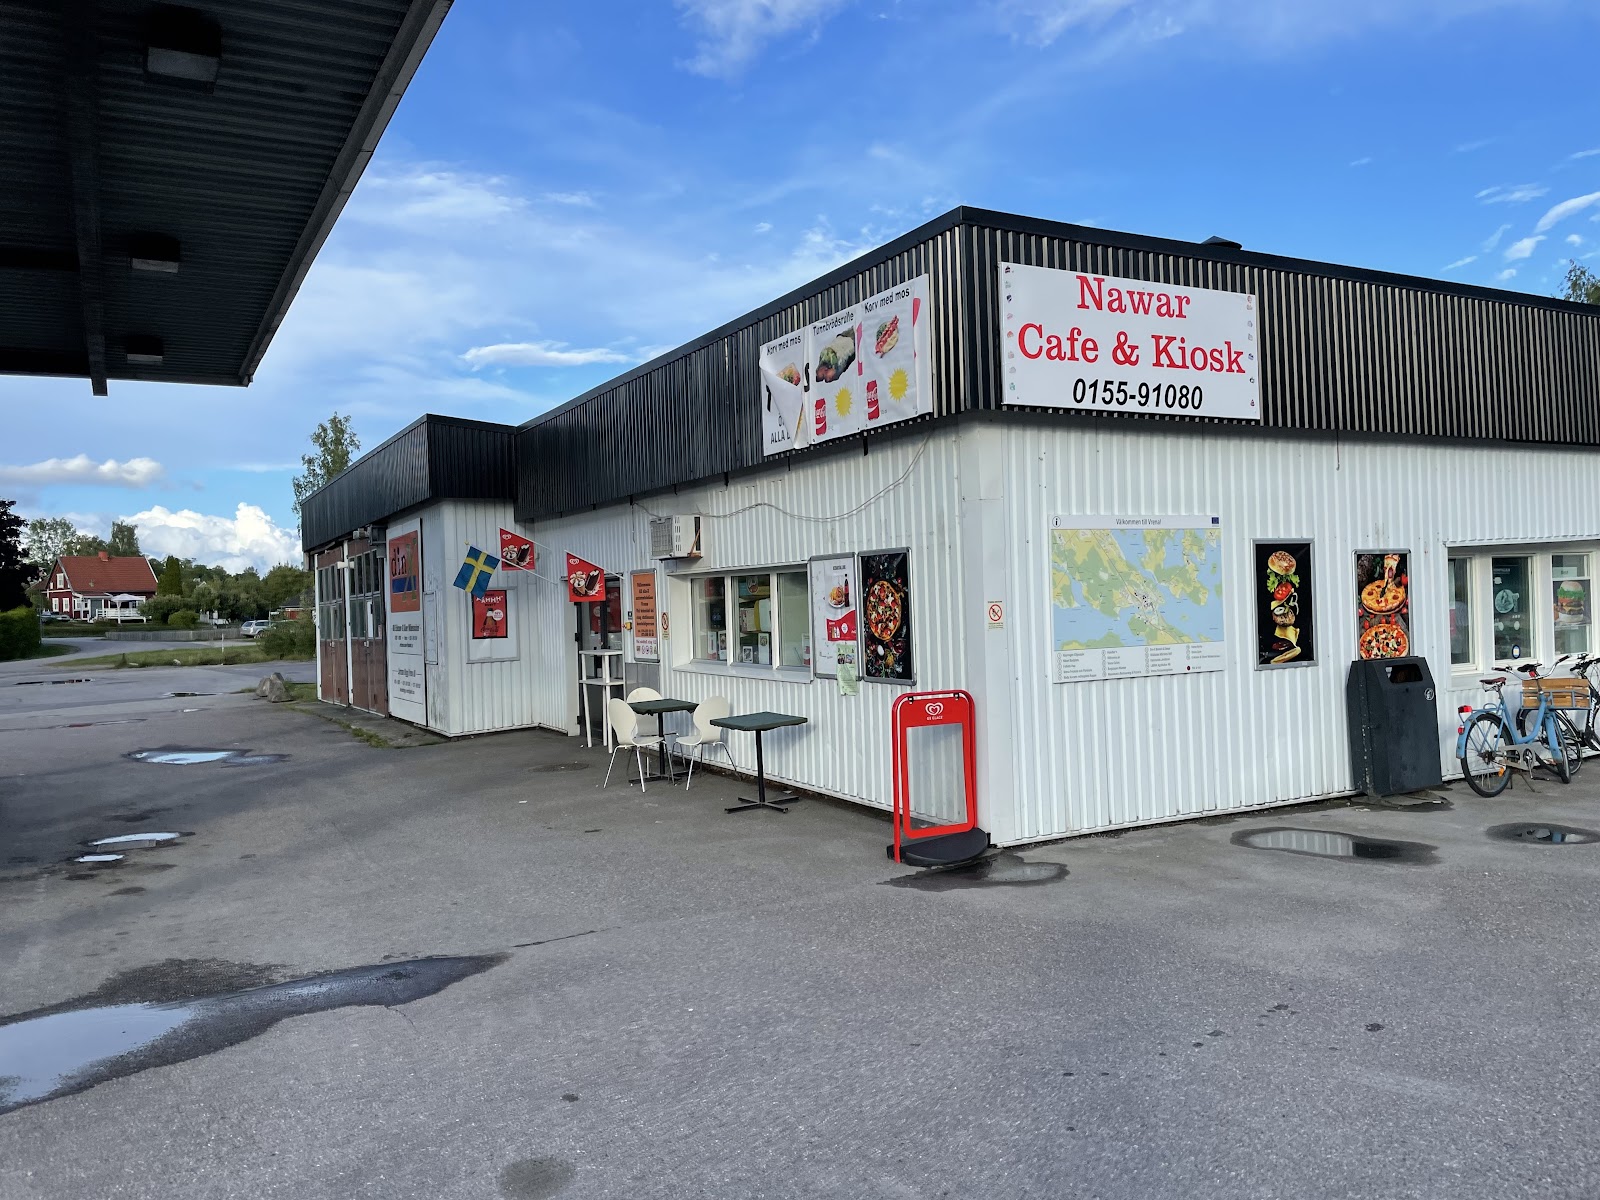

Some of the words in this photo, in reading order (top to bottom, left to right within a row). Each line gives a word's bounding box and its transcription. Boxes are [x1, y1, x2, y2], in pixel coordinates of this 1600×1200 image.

[864, 301, 878, 314] Korv
[879, 291, 894, 307] med
[895, 287, 910, 302] mos
[1075, 274, 1191, 319] Nawar
[766, 345, 778, 356] Korv
[778, 338, 789, 352] med
[789, 335, 802, 347] mos
[1018, 322, 1099, 364] Cafe
[1111, 330, 1140, 367] &
[1151, 334, 1246, 374] Kiosk
[1072, 377, 1203, 410] 0155-91080
[770, 430, 786, 444] ALLA
[1116, 518, 1141, 526] Välkommen
